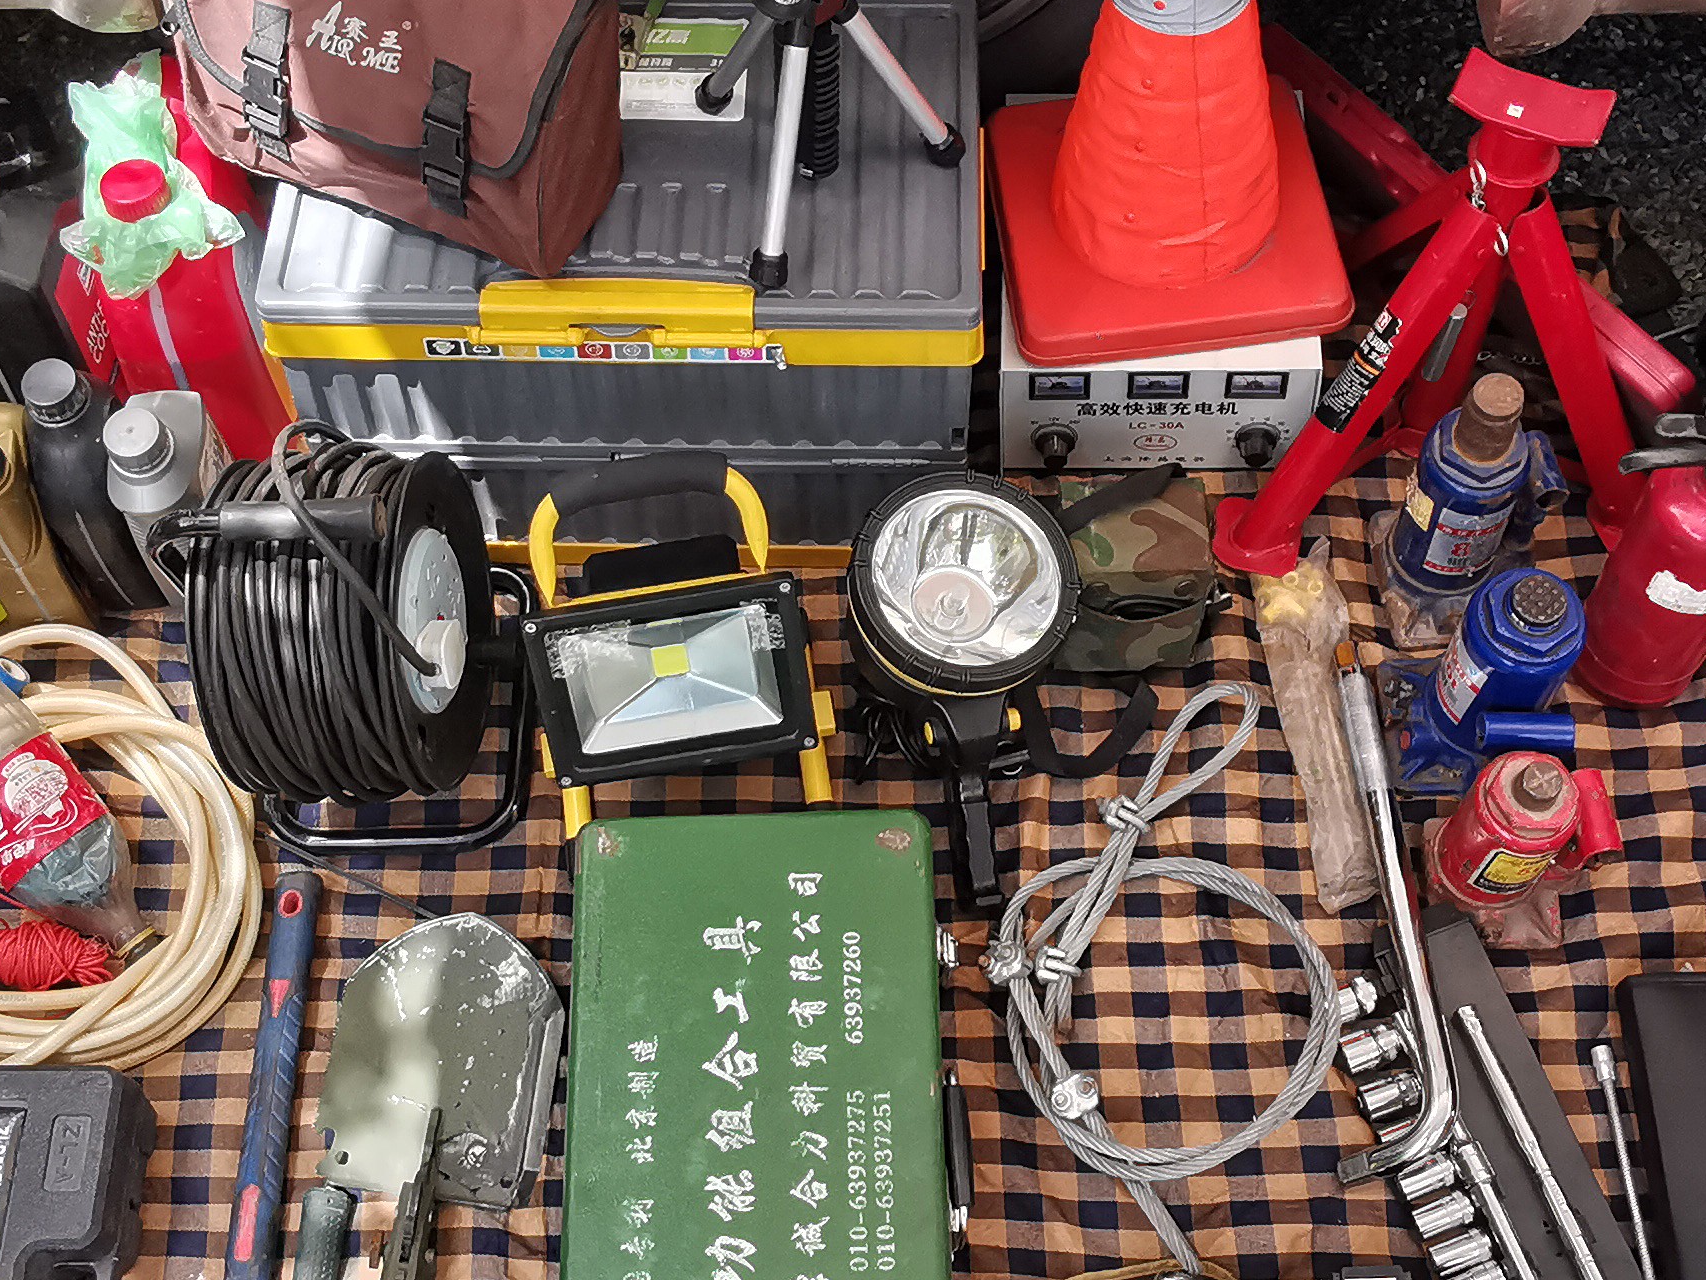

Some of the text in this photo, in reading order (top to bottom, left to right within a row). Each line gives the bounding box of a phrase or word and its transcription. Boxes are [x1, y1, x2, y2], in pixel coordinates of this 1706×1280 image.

[305, 0, 357, 66] AIR
[1075, 401, 1240, 417] 高效快速充电机
[840, 930, 864, 1045] 63937260
[625, 1033, 662, 1166] 北京制造
